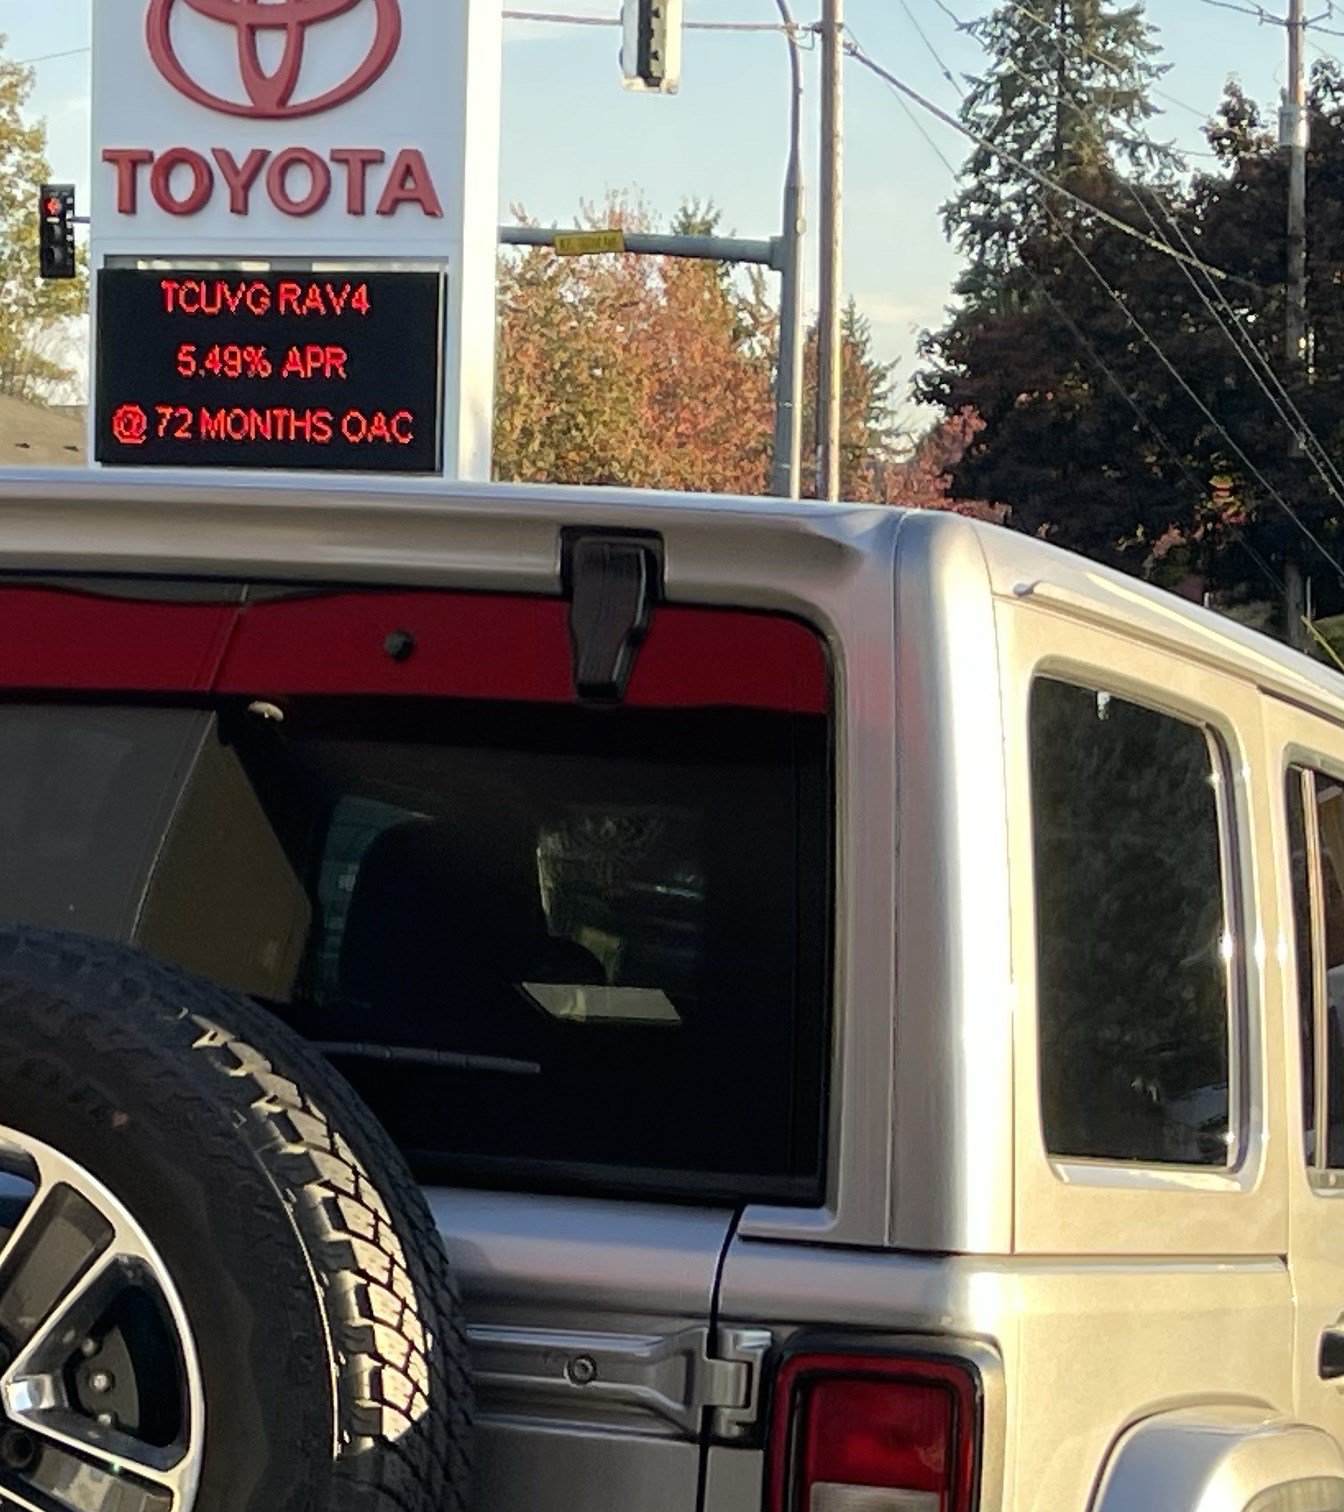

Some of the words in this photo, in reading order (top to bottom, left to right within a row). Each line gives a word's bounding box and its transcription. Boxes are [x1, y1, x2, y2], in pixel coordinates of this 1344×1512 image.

[102, 146, 444, 217] TOYOTA
[160, 280, 272, 316] TCUVG
[277, 282, 371, 317] RAV4
[177, 344, 272, 378] 5.49%
[281, 345, 349, 379] APR
[111, 403, 148, 445] @
[155, 406, 193, 440] 72
[199, 406, 334, 444] MONTHS
[341, 411, 414, 445] OAC
